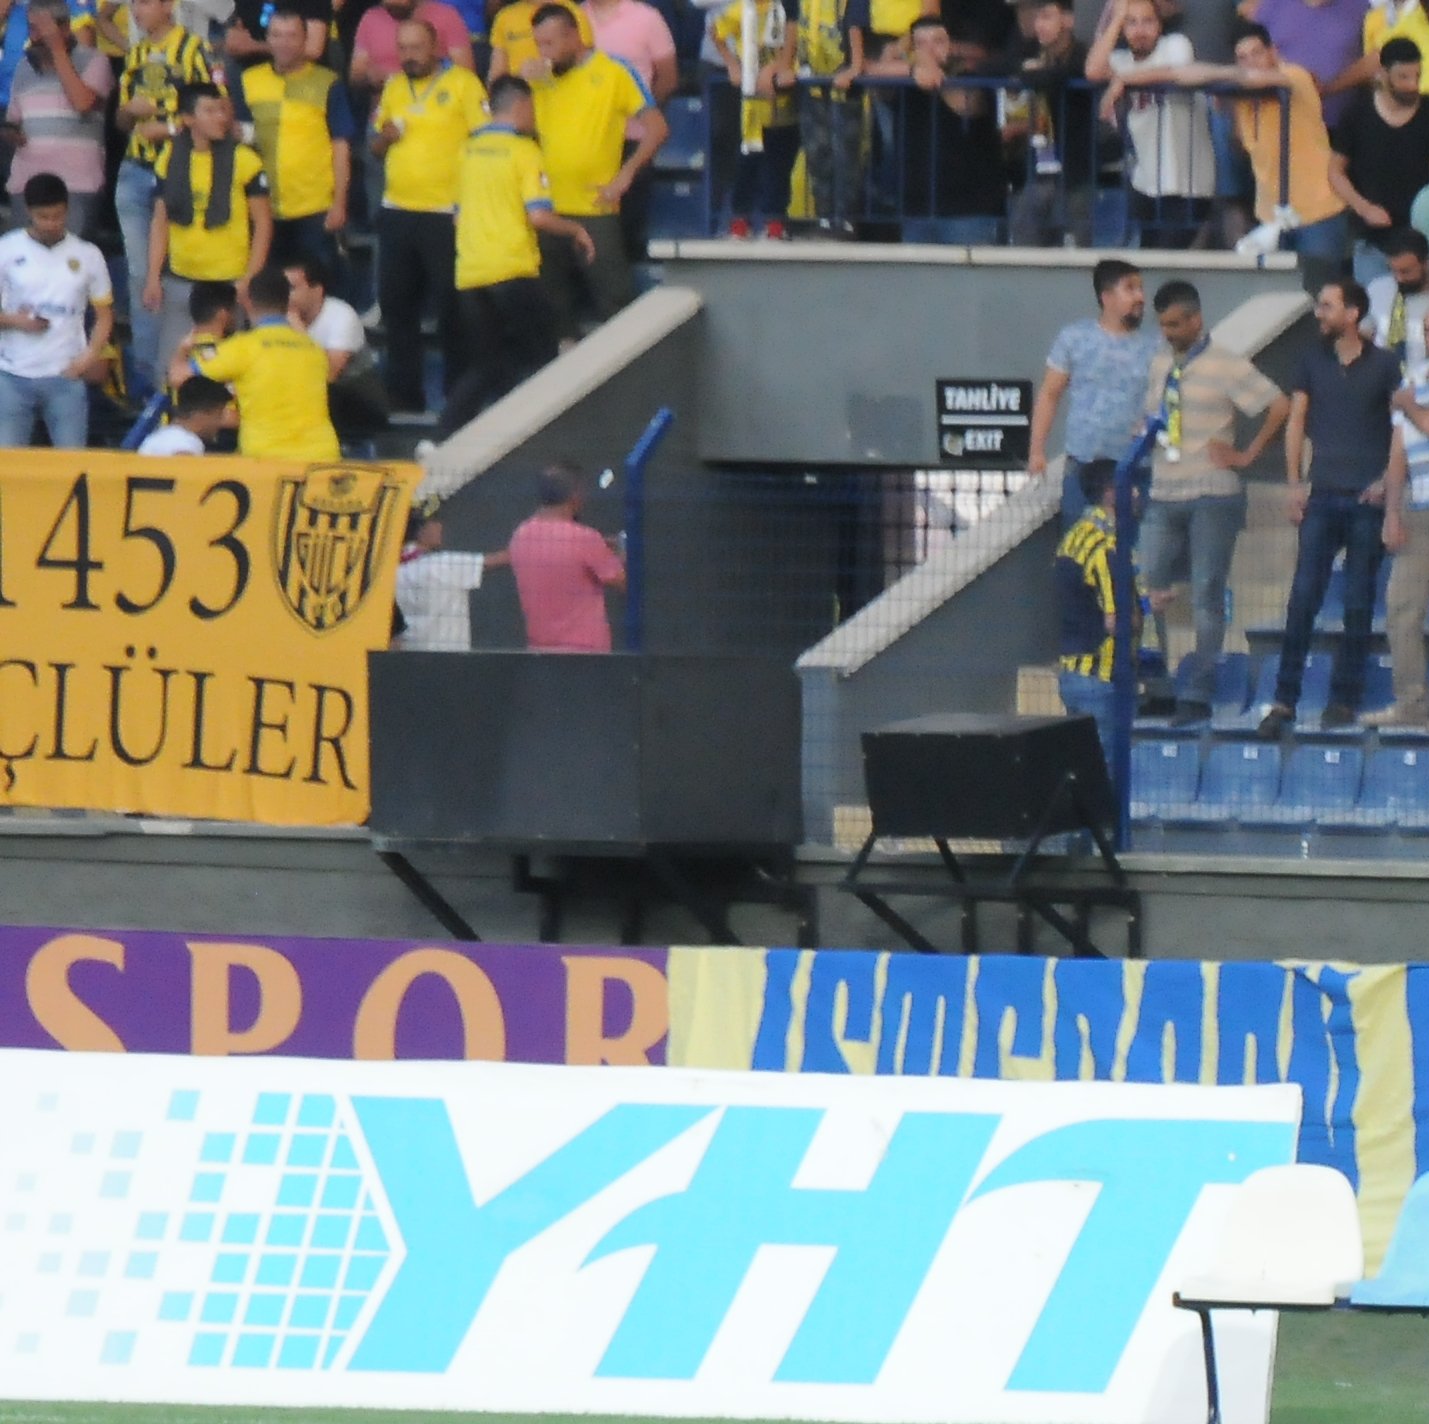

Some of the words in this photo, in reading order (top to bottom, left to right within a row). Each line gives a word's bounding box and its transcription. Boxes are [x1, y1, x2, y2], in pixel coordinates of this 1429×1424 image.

[965, 429, 1004, 451] EXIT
[0, 473, 252, 620] 453
[346, 1094, 1296, 1394] YHT
